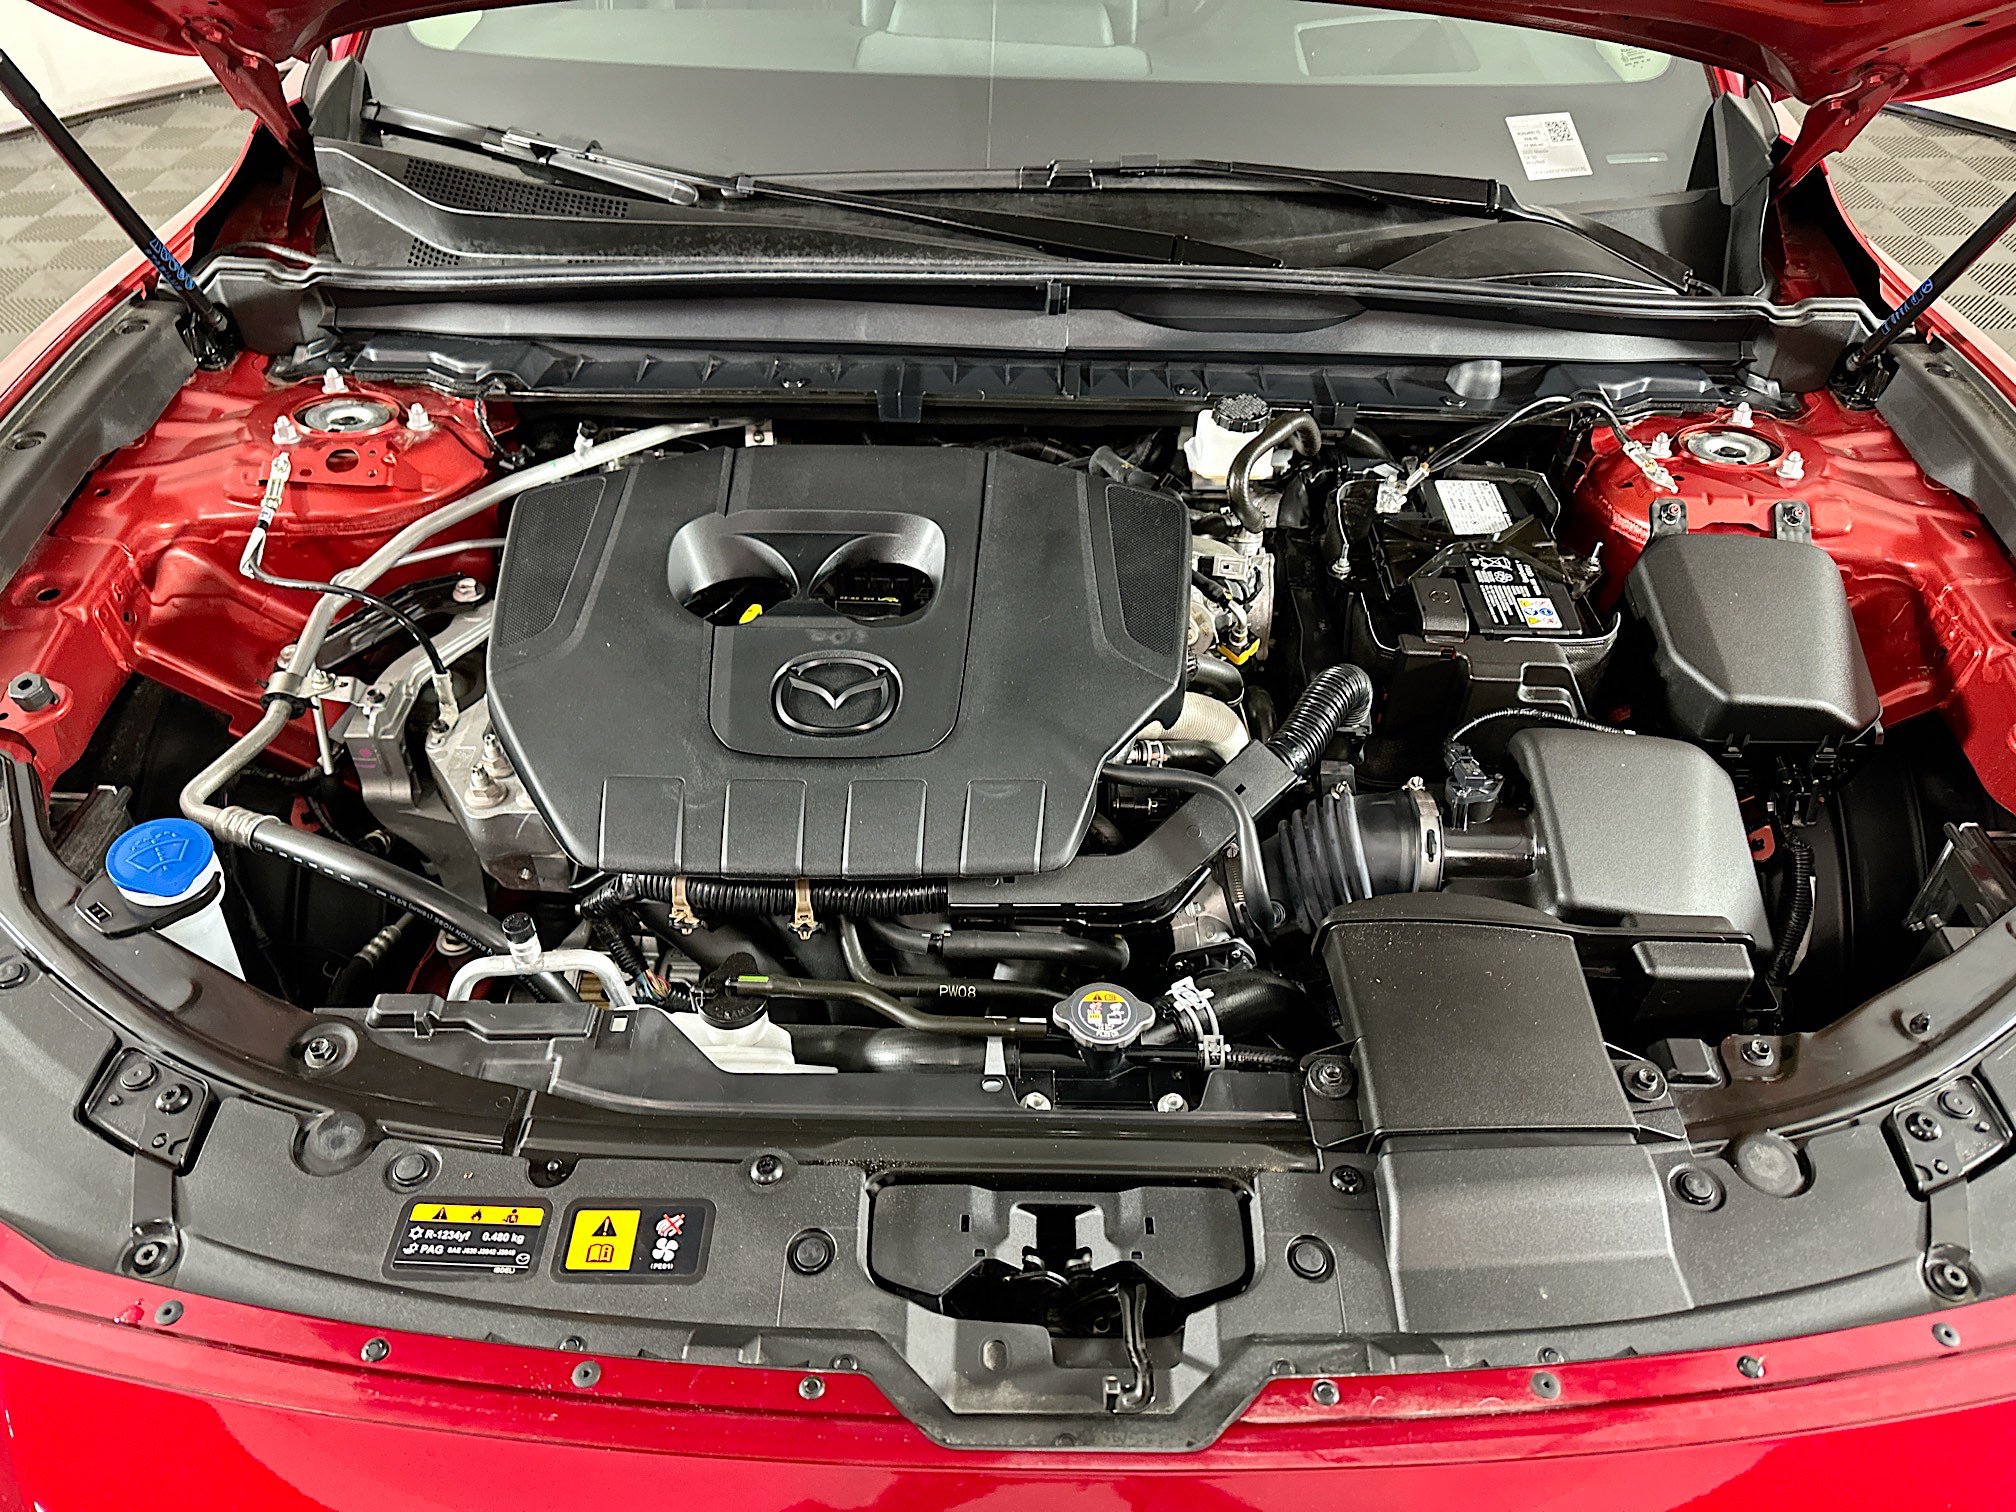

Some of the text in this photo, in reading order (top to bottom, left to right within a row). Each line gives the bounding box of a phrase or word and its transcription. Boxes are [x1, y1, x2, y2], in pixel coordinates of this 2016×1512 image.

[424, 1229, 472, 1243] R-1234yf
[510, 1232, 525, 1245] kg
[419, 1244, 445, 1255] PAG
